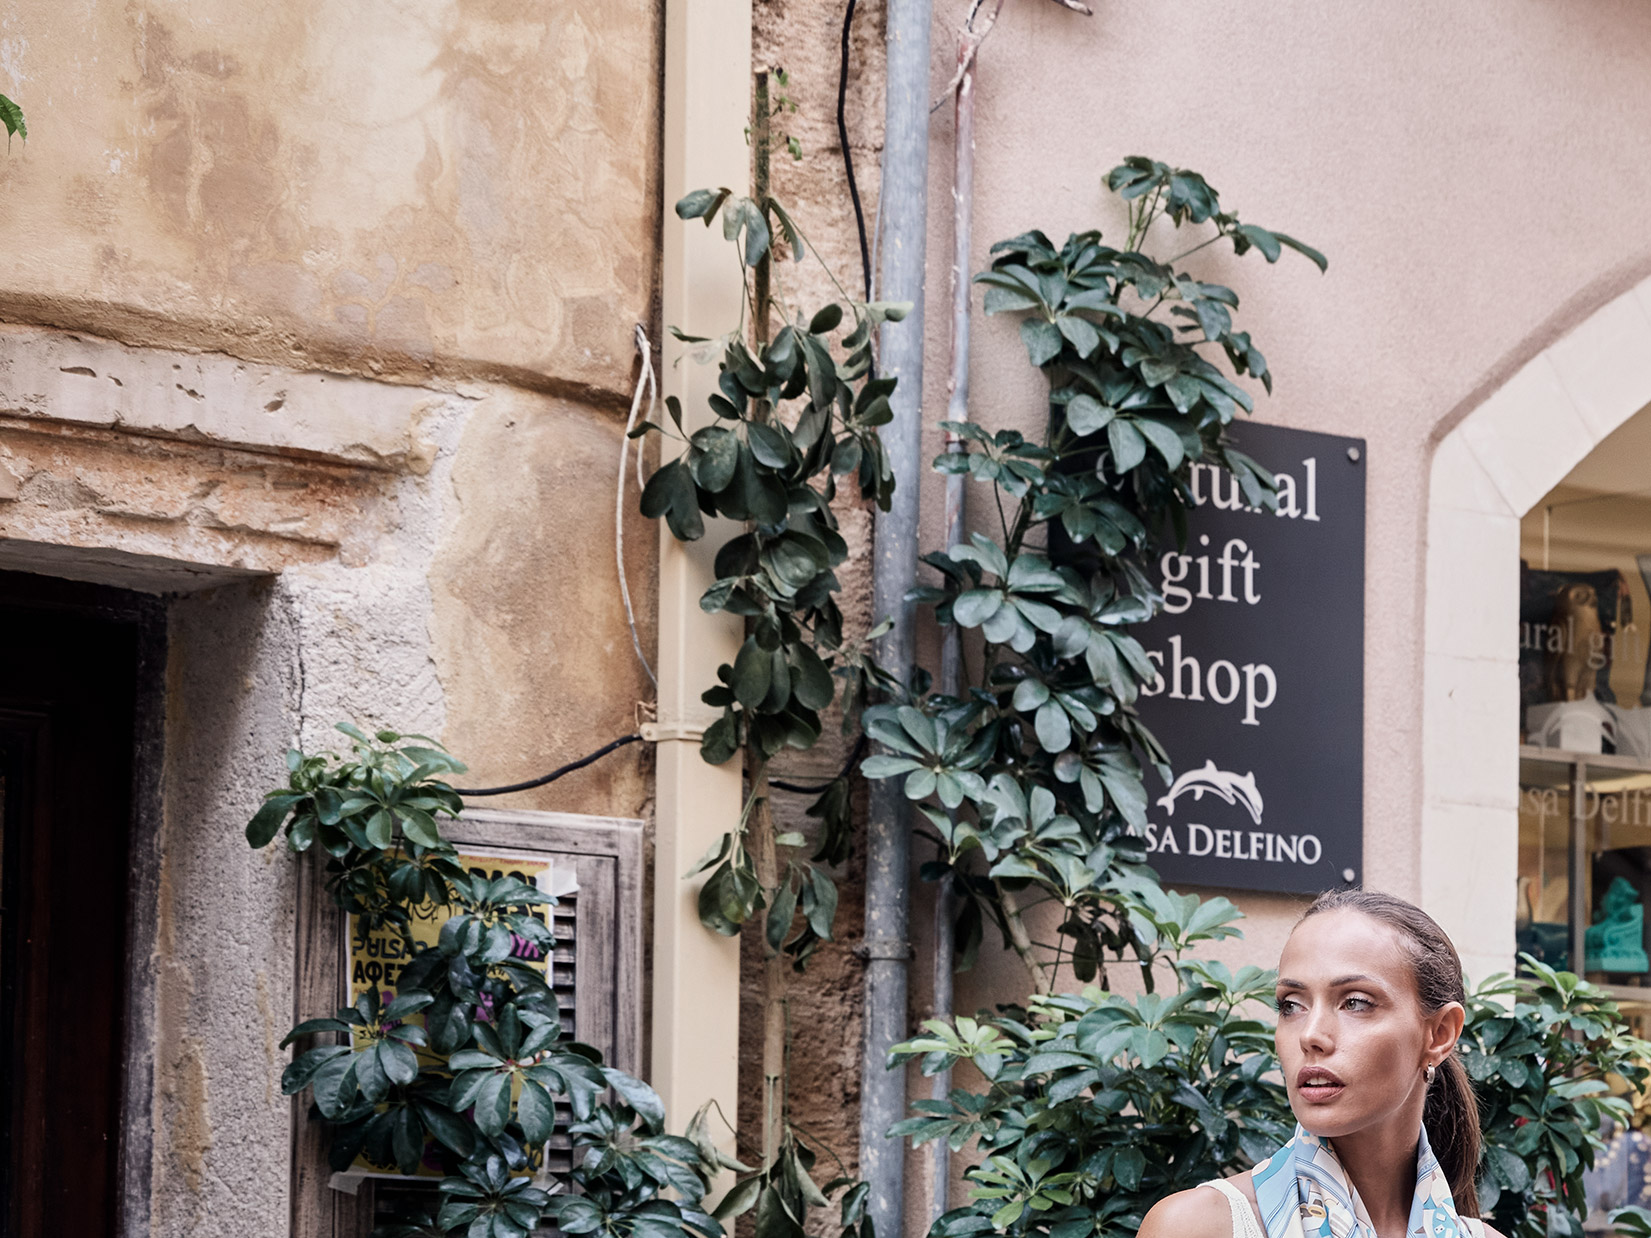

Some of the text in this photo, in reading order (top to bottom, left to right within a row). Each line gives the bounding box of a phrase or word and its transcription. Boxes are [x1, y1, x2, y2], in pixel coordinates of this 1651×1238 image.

[1160, 534, 1261, 614] gift
[1140, 634, 1277, 726] shop
[1186, 823, 1323, 866] DELFINO
